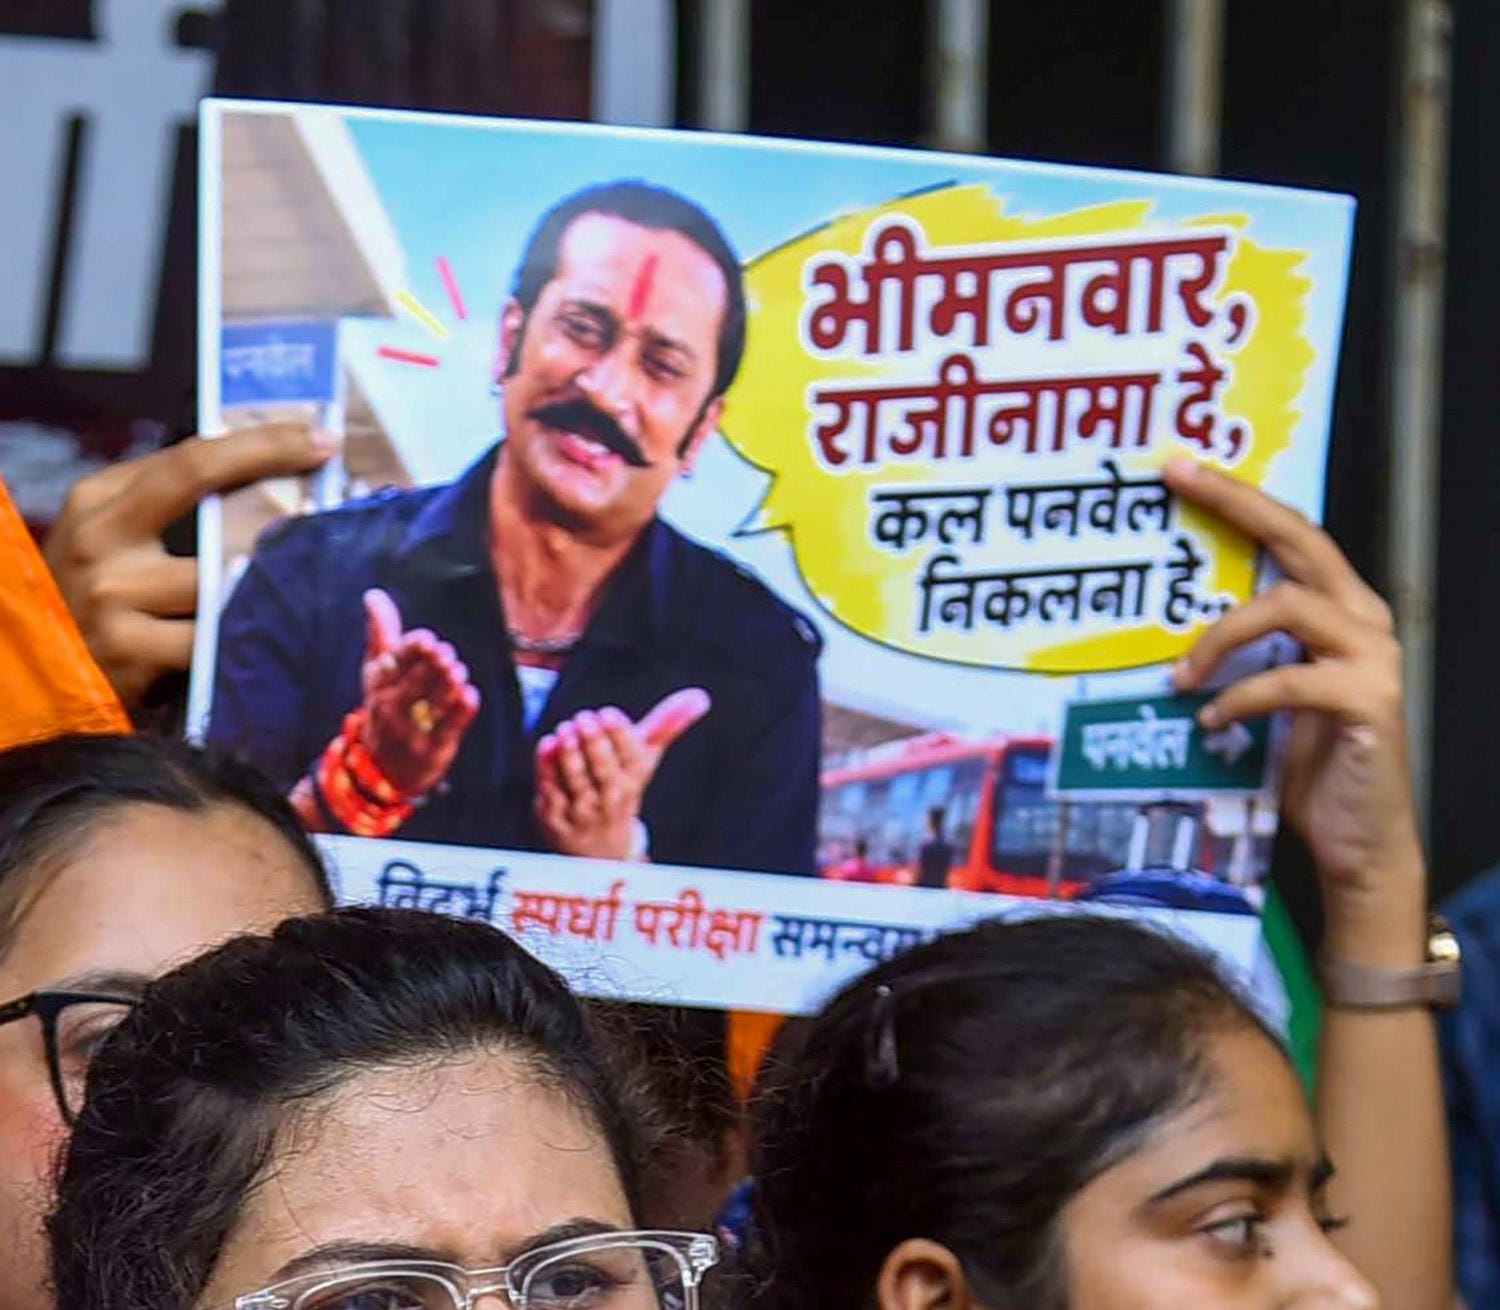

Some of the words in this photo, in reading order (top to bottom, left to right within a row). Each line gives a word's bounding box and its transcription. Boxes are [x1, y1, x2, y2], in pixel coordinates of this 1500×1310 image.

[808, 224, 1246, 354] भीमनवार,
[815, 352, 1160, 464] राजीनामा
[1174, 342, 1242, 458] दे,
[874, 487, 990, 548] कल
[1006, 458, 1176, 540] पनवेल
[918, 554, 1152, 632] निकलना
[510, 882, 626, 945] स्पर्धा
[632, 890, 764, 962] परीक्षा
